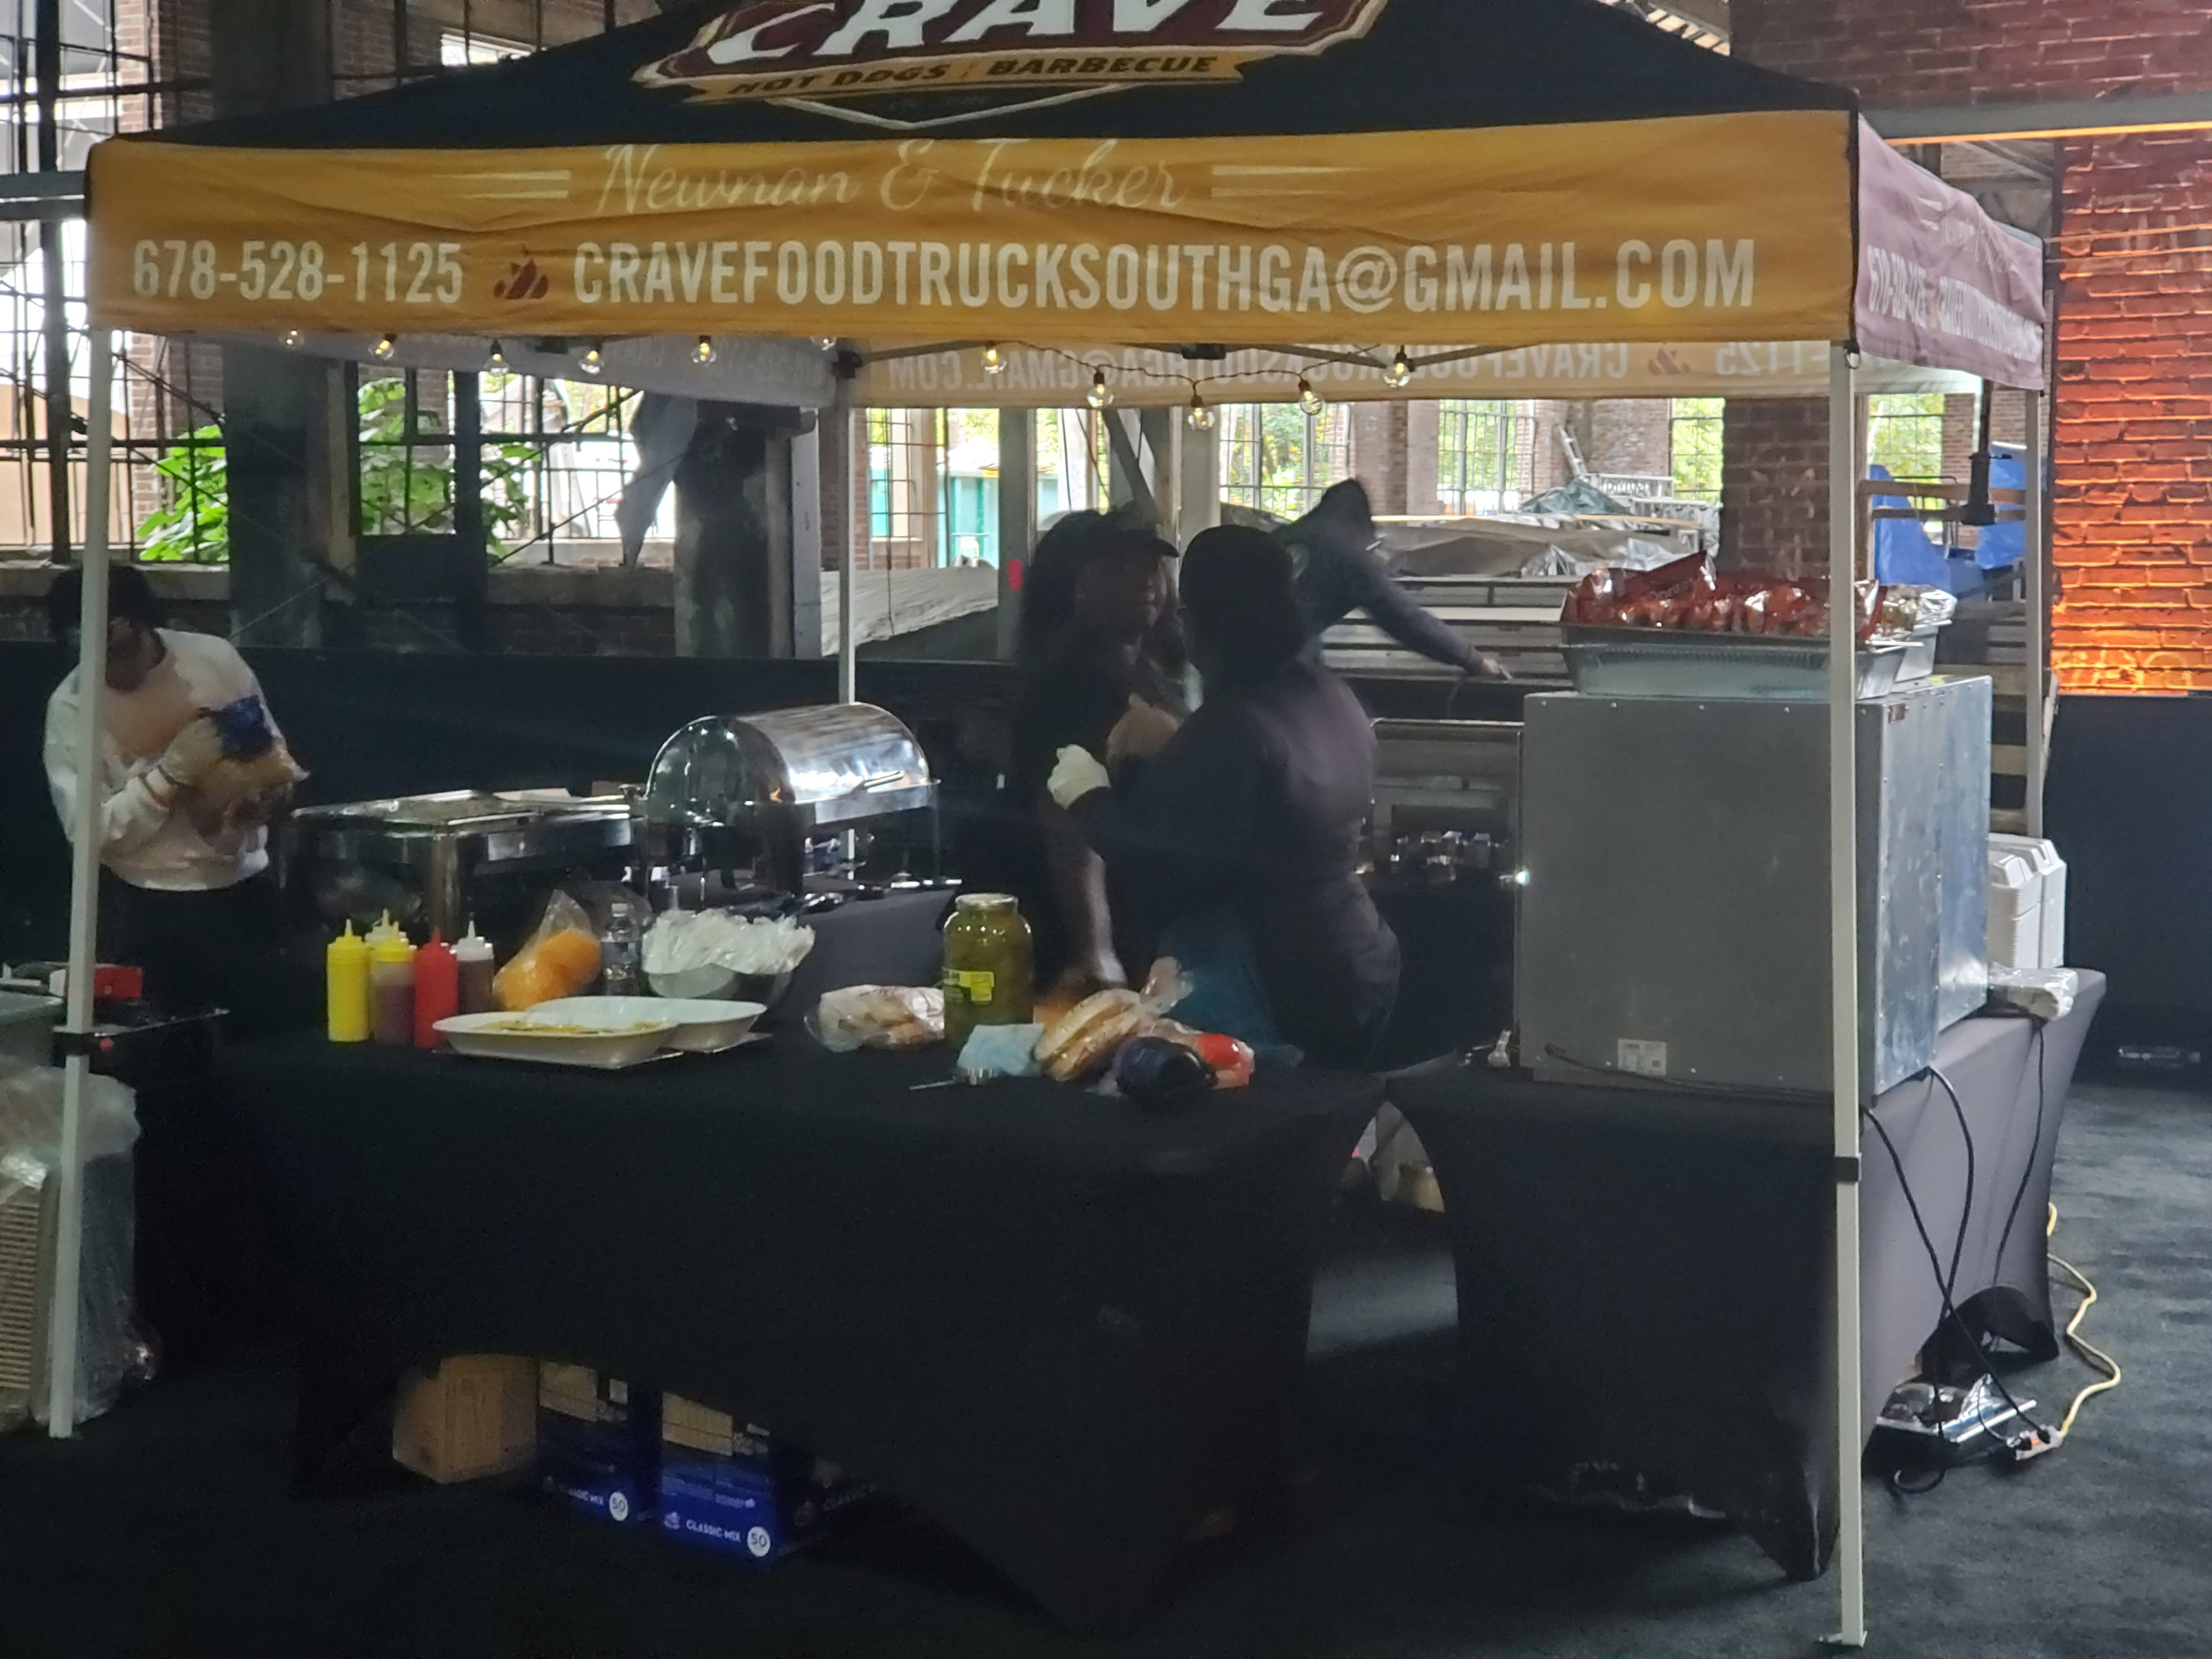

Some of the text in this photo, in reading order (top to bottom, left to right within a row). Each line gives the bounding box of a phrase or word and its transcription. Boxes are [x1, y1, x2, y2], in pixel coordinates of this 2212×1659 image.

[727, 55, 1218, 95] HOT DOGS BARBECUE
[972, 138, 1188, 211] Tucker
[133, 238, 1754, 311] 678-528-1125 CRAVEFOODTRUCKSOUTHGA@GMAIL.COM
[686, 1519, 768, 1548] CLASSIC MIX 50
